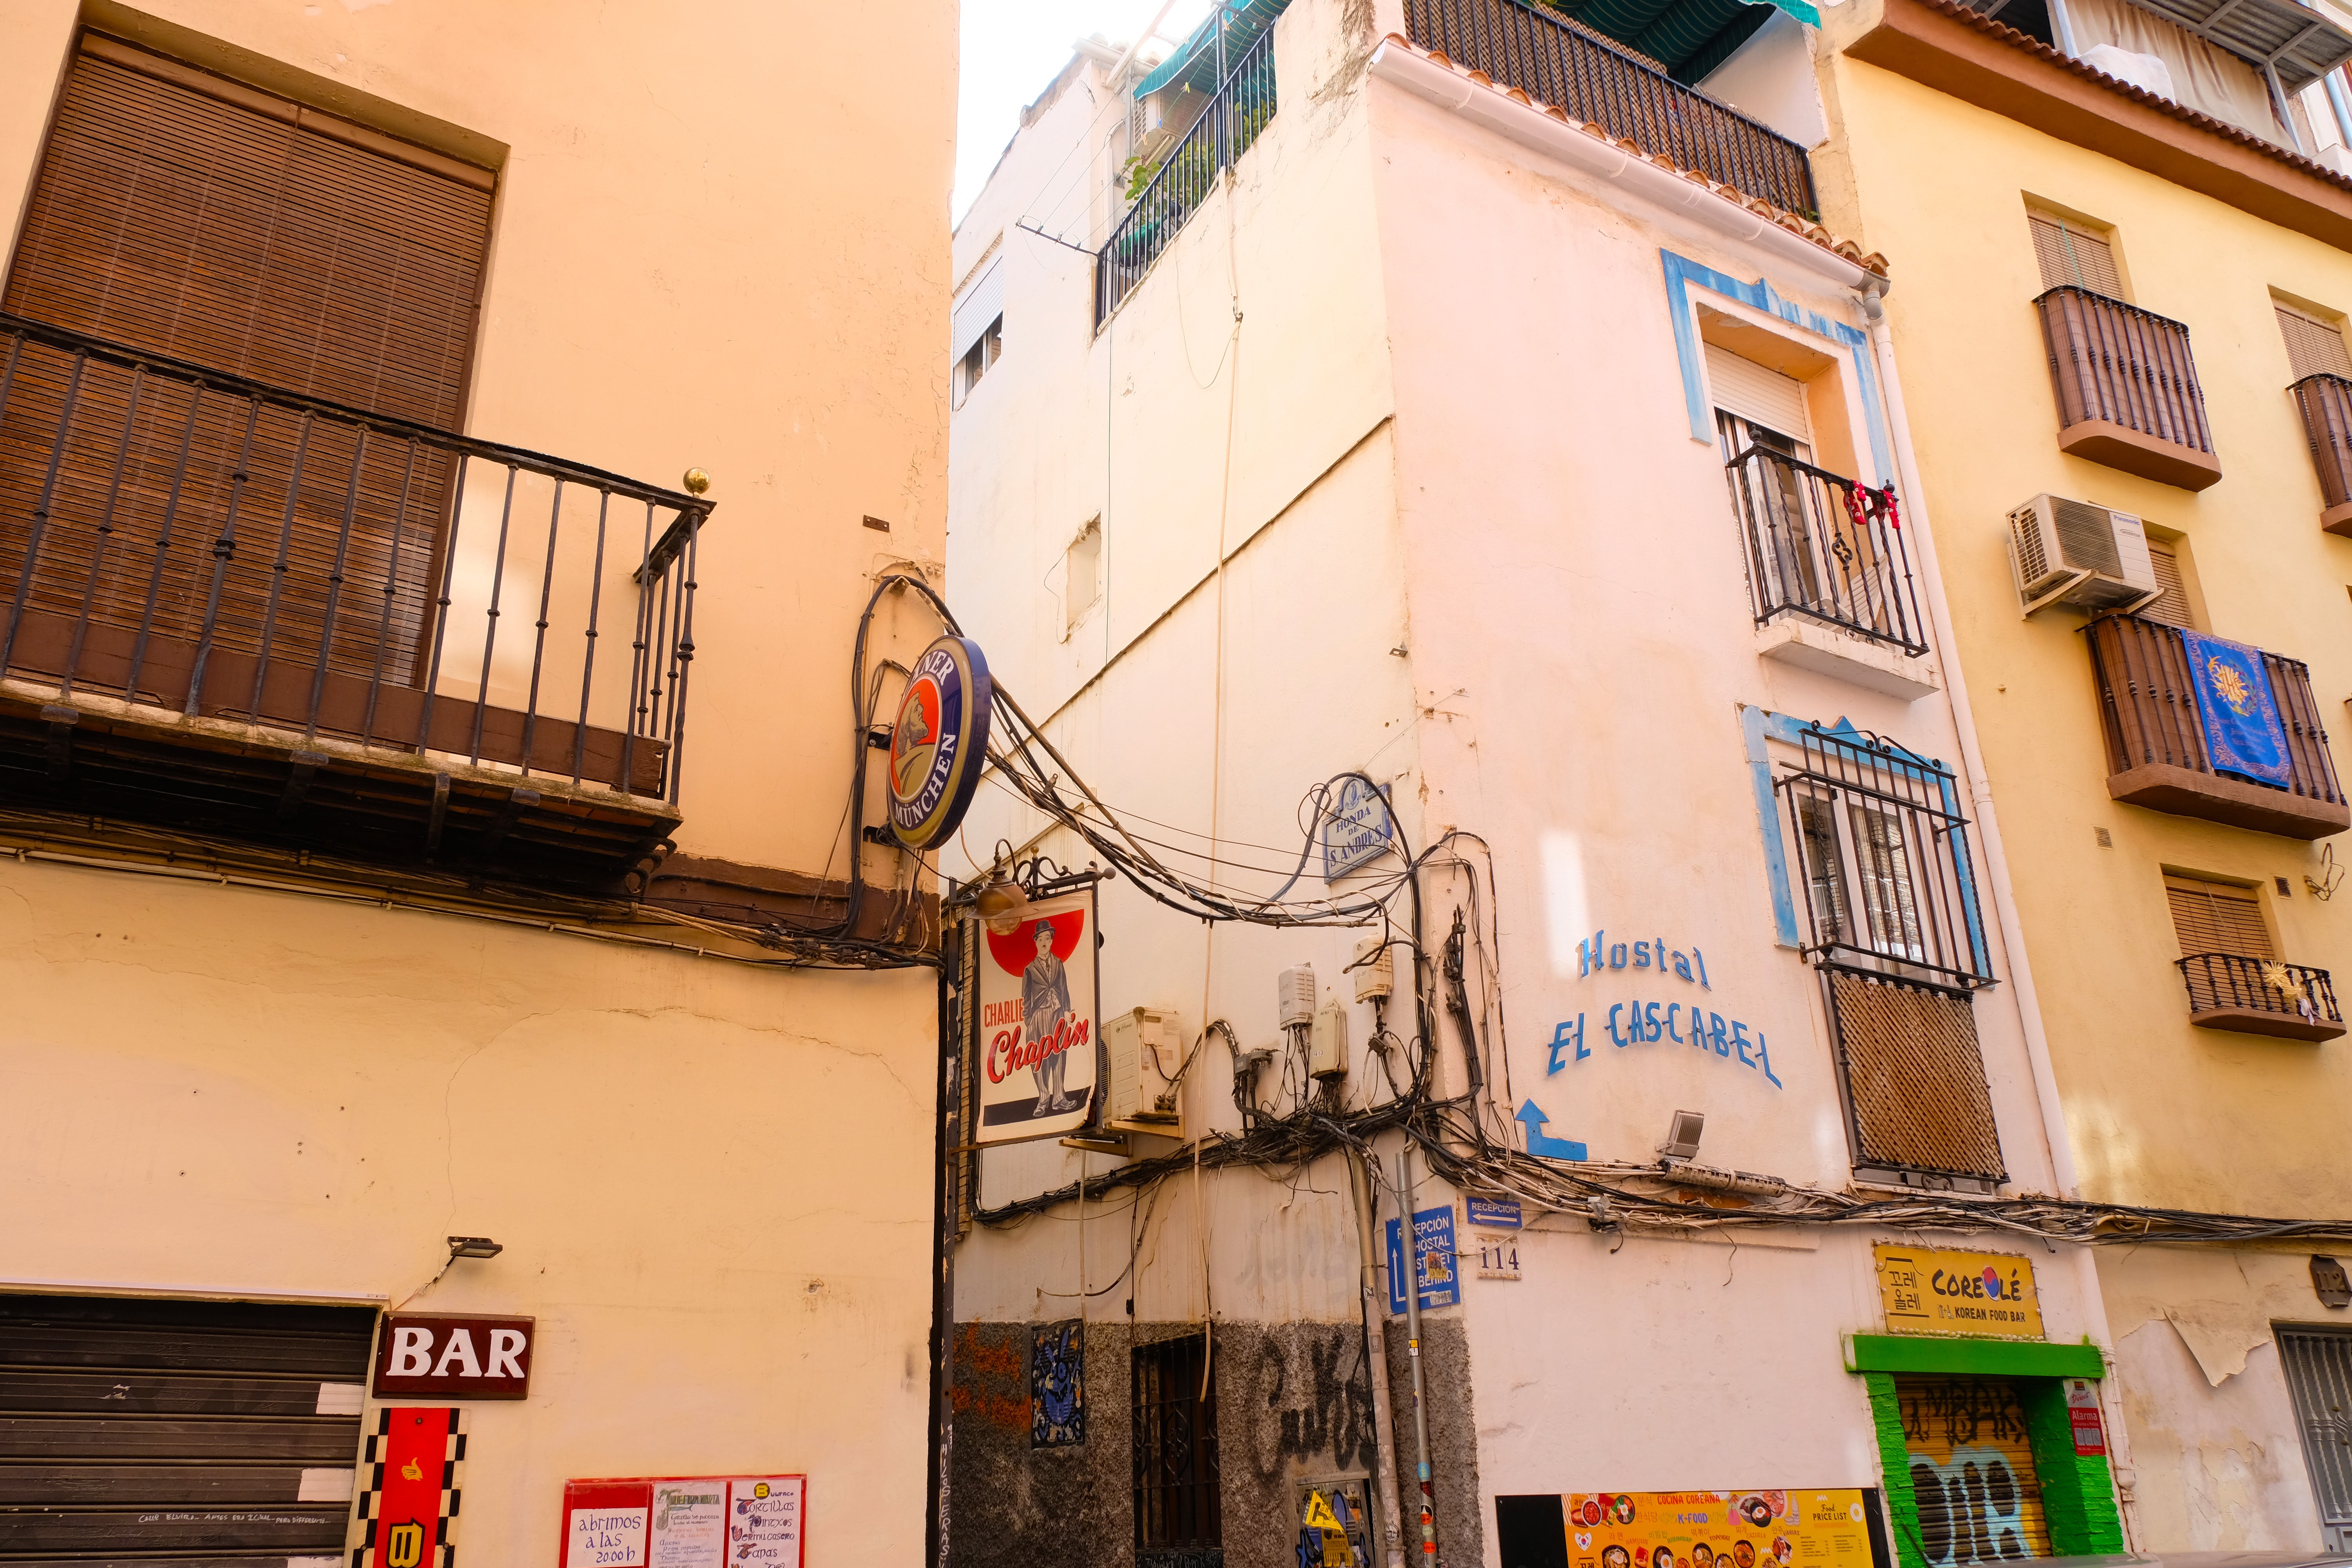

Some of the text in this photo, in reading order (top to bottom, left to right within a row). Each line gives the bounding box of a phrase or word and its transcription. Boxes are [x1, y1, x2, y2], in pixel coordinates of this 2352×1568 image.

[895, 732, 956, 828] MÜNCHEN
[1336, 806, 1371, 833] HONDA
[1348, 825, 1359, 836] DE
[1581, 929, 1711, 991] Hostal
[984, 998, 1024, 1027] CHARLIE
[987, 1013, 1089, 1083] Chaplin
[1548, 1000, 1782, 1090] EL CASCABEL
[1472, 1202, 1516, 1214] RECEPCIÓN
[1397, 1215, 1449, 1240] REPCIÓN
[1415, 1234, 1450, 1252] HOSTAL
[1416, 1252, 1450, 1270] STET
[1480, 1247, 1519, 1270] 114
[1889, 1271, 1917, 1289] 꼬레
[2316, 1270, 2346, 1292] 112
[1894, 1289, 1921, 1310] 올레
[1955, 1307, 2025, 1322] KOREAN FOOD BAR
[386, 1327, 526, 1378] BAR
[2073, 1411, 2097, 1421] Alarma
[1657, 1494, 1721, 1505] COCINA COREANA
[579, 1514, 641, 1531] abrimos
[1678, 1513, 1708, 1524] K-FOOD
[586, 1532, 623, 1548] a las
[596, 1546, 635, 1563] 20:00 h
